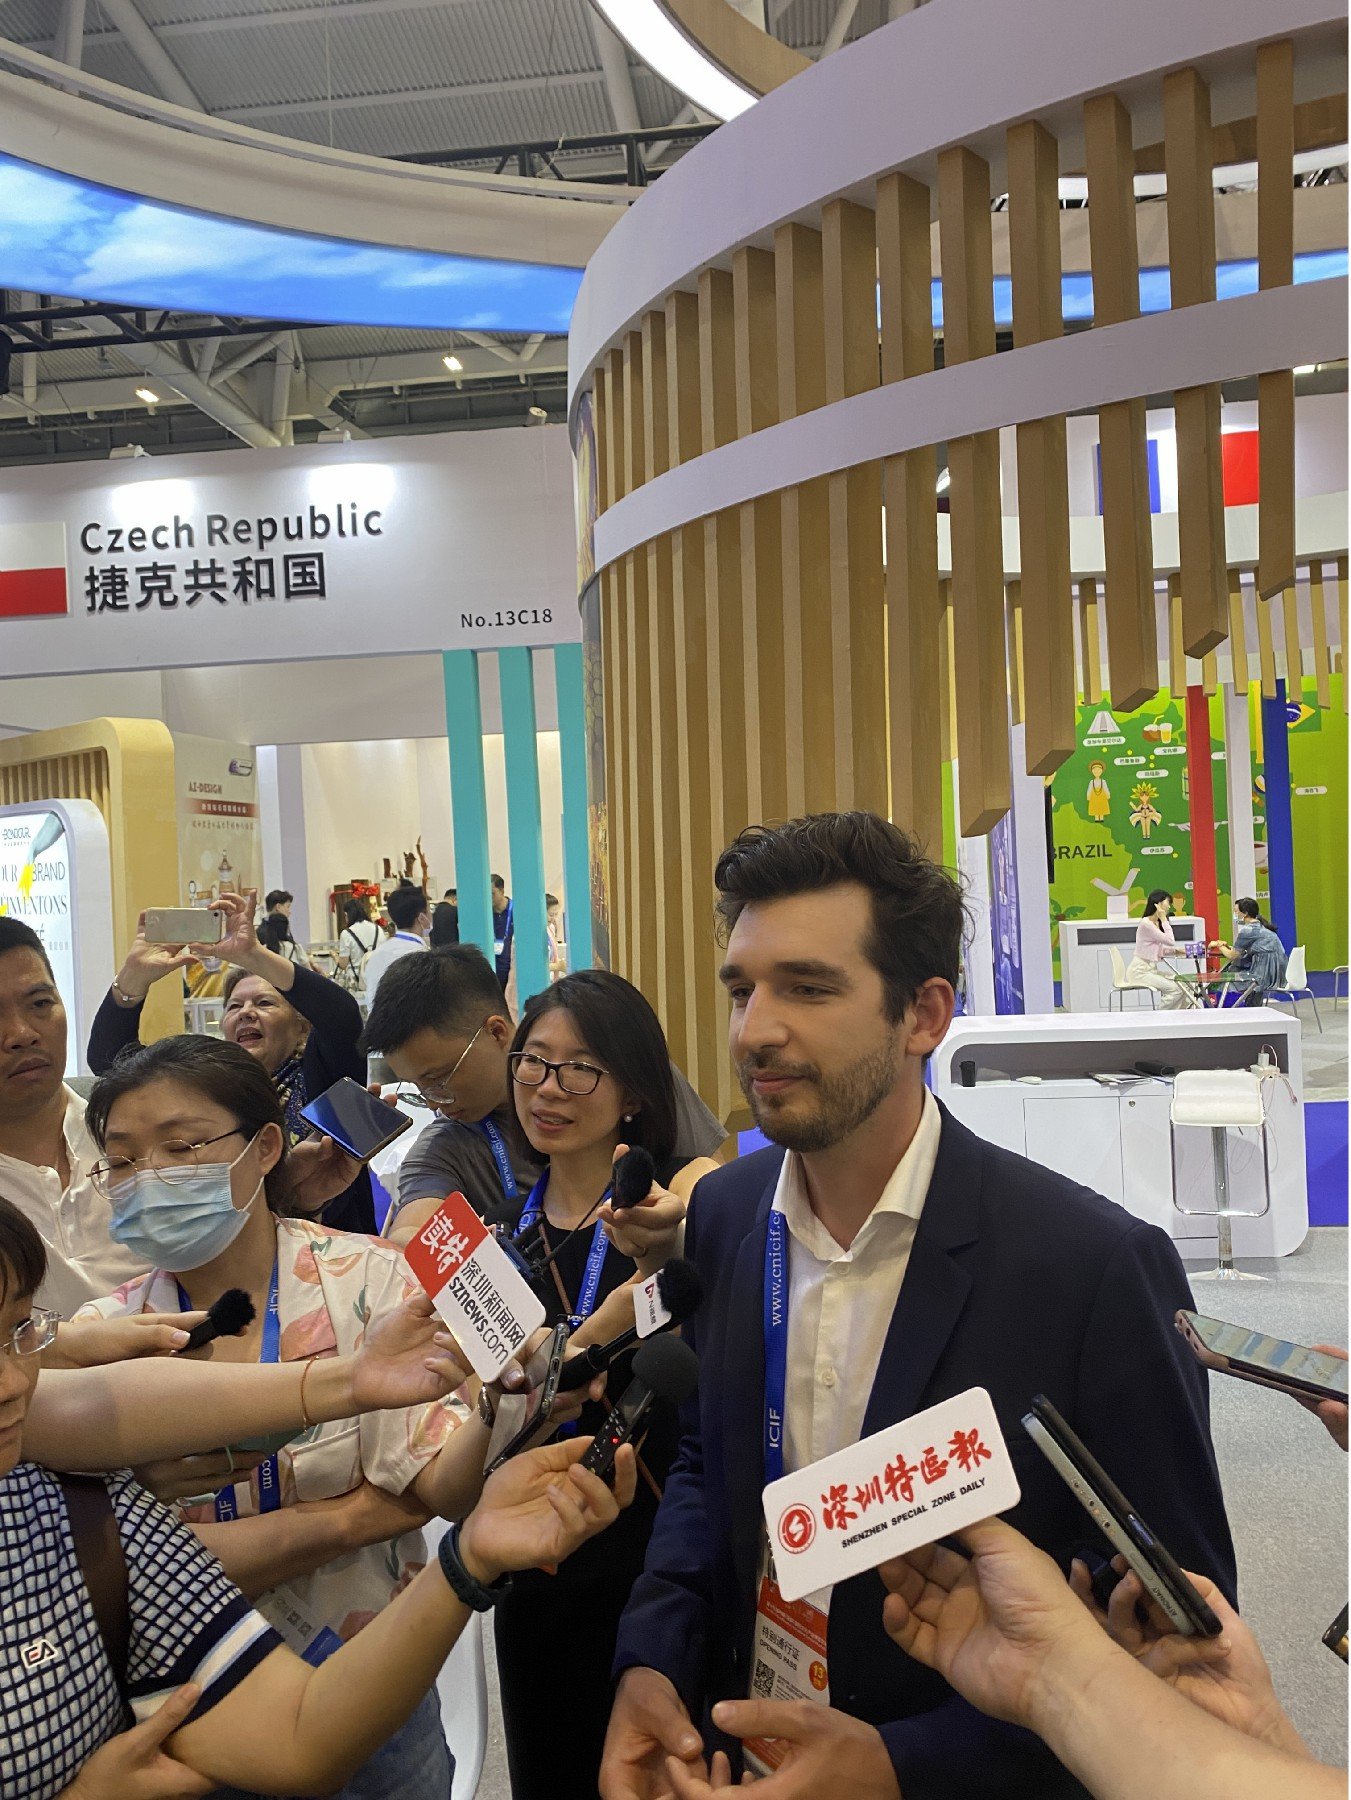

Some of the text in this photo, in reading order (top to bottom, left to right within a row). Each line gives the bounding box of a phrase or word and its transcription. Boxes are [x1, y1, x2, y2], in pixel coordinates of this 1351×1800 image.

[81, 501, 384, 553] Czech Republic
[84, 552, 327, 613] 捷克共和国
[461, 608, 553, 628] No.13C18
[449, 1276, 509, 1365] sznews.com
[461, 1257, 526, 1350] 深圳新闻网
[769, 1407, 780, 1448] ICIF
[841, 1477, 986, 1549] SHENZHEN SPECIAL ZONE DAILY
